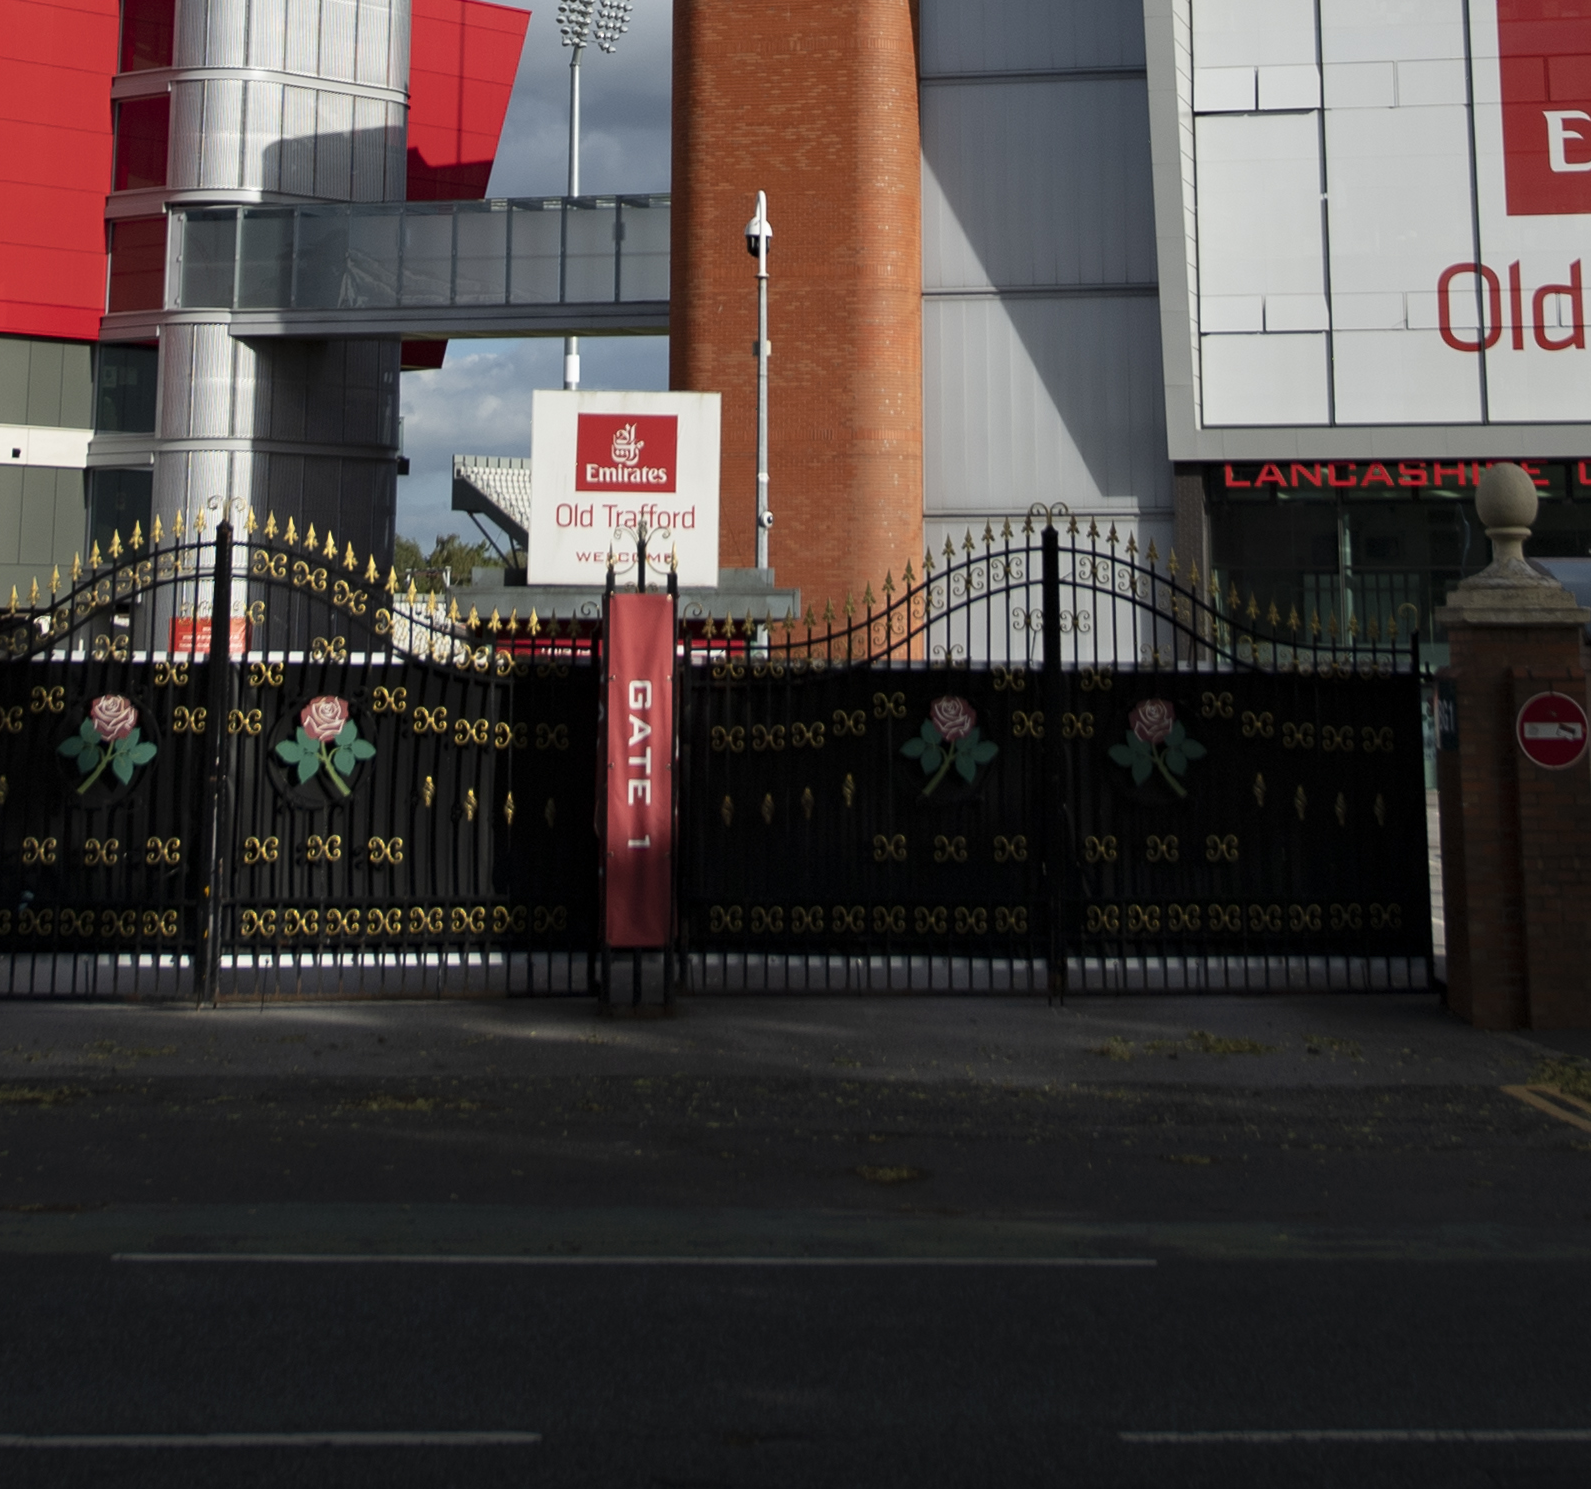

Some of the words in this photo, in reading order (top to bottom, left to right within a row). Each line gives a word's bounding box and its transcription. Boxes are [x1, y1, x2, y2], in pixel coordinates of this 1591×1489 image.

[1437, 258, 1586, 352] Old
[586, 463, 668, 484] Emirates
[1224, 459, 1549, 488] LANCASHIE
[556, 503, 594, 528] Old
[602, 503, 696, 529] Trafford
[627, 679, 652, 807] GATE
[627, 834, 651, 849] 1
